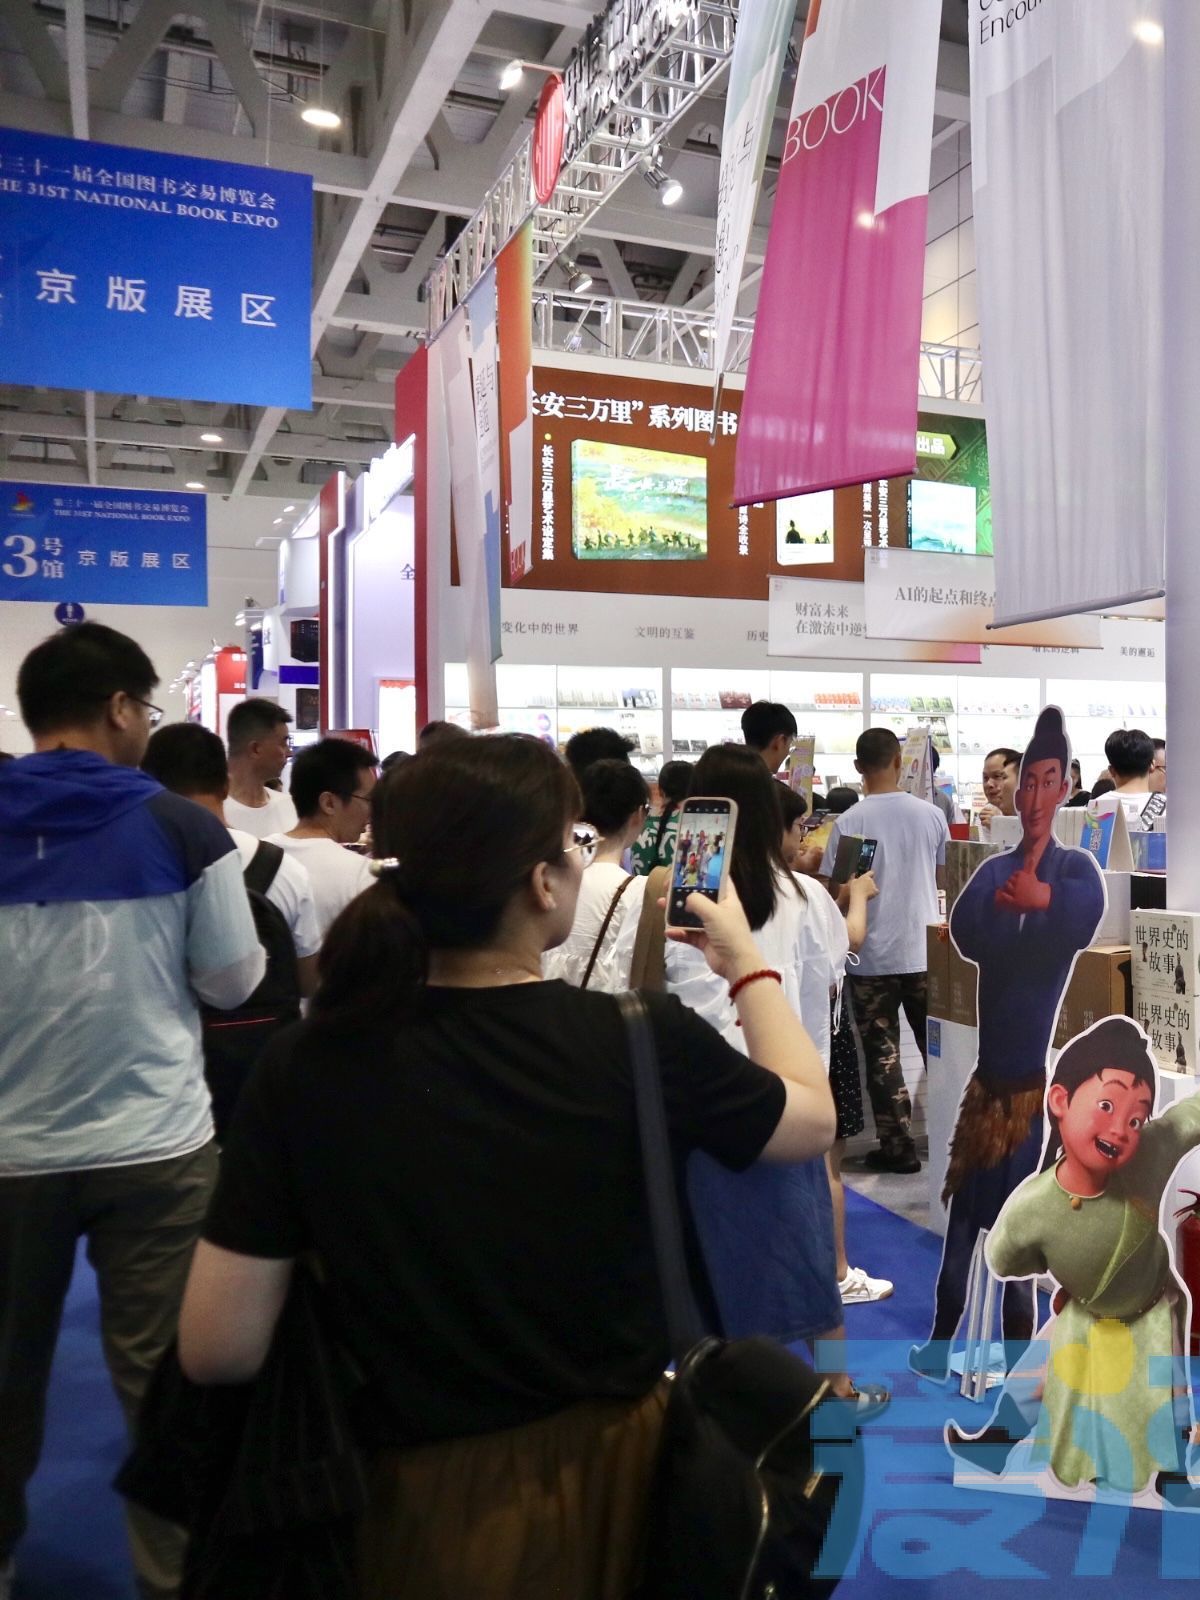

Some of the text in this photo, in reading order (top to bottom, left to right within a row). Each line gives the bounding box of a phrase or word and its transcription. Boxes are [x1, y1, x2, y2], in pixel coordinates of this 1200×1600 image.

[782, 66, 884, 165] BOOK
[0, 156, 277, 211] 三十一届全国图书交易博览会
[27, 182, 70, 200] 31ST
[74, 188, 172, 214] NATIONAL
[176, 203, 228, 222] BOOK
[231, 211, 279, 229] EXPO
[36, 267, 277, 327] 京版展区
[2, 534, 38, 578] 3
[78, 550, 191, 569] 京版展区
[795, 602, 849, 618] 财富未来
[501, 621, 579, 635] 变化中的世界
[634, 626, 695, 640] 文明的互鉴
[795, 620, 868, 638] 在激流中逆
[1135, 924, 1189, 950] 世界史的
[1149, 951, 1175, 974] 故事
[1137, 1001, 1190, 1031] 世界史的
[1151, 1029, 1176, 1052] 故事
